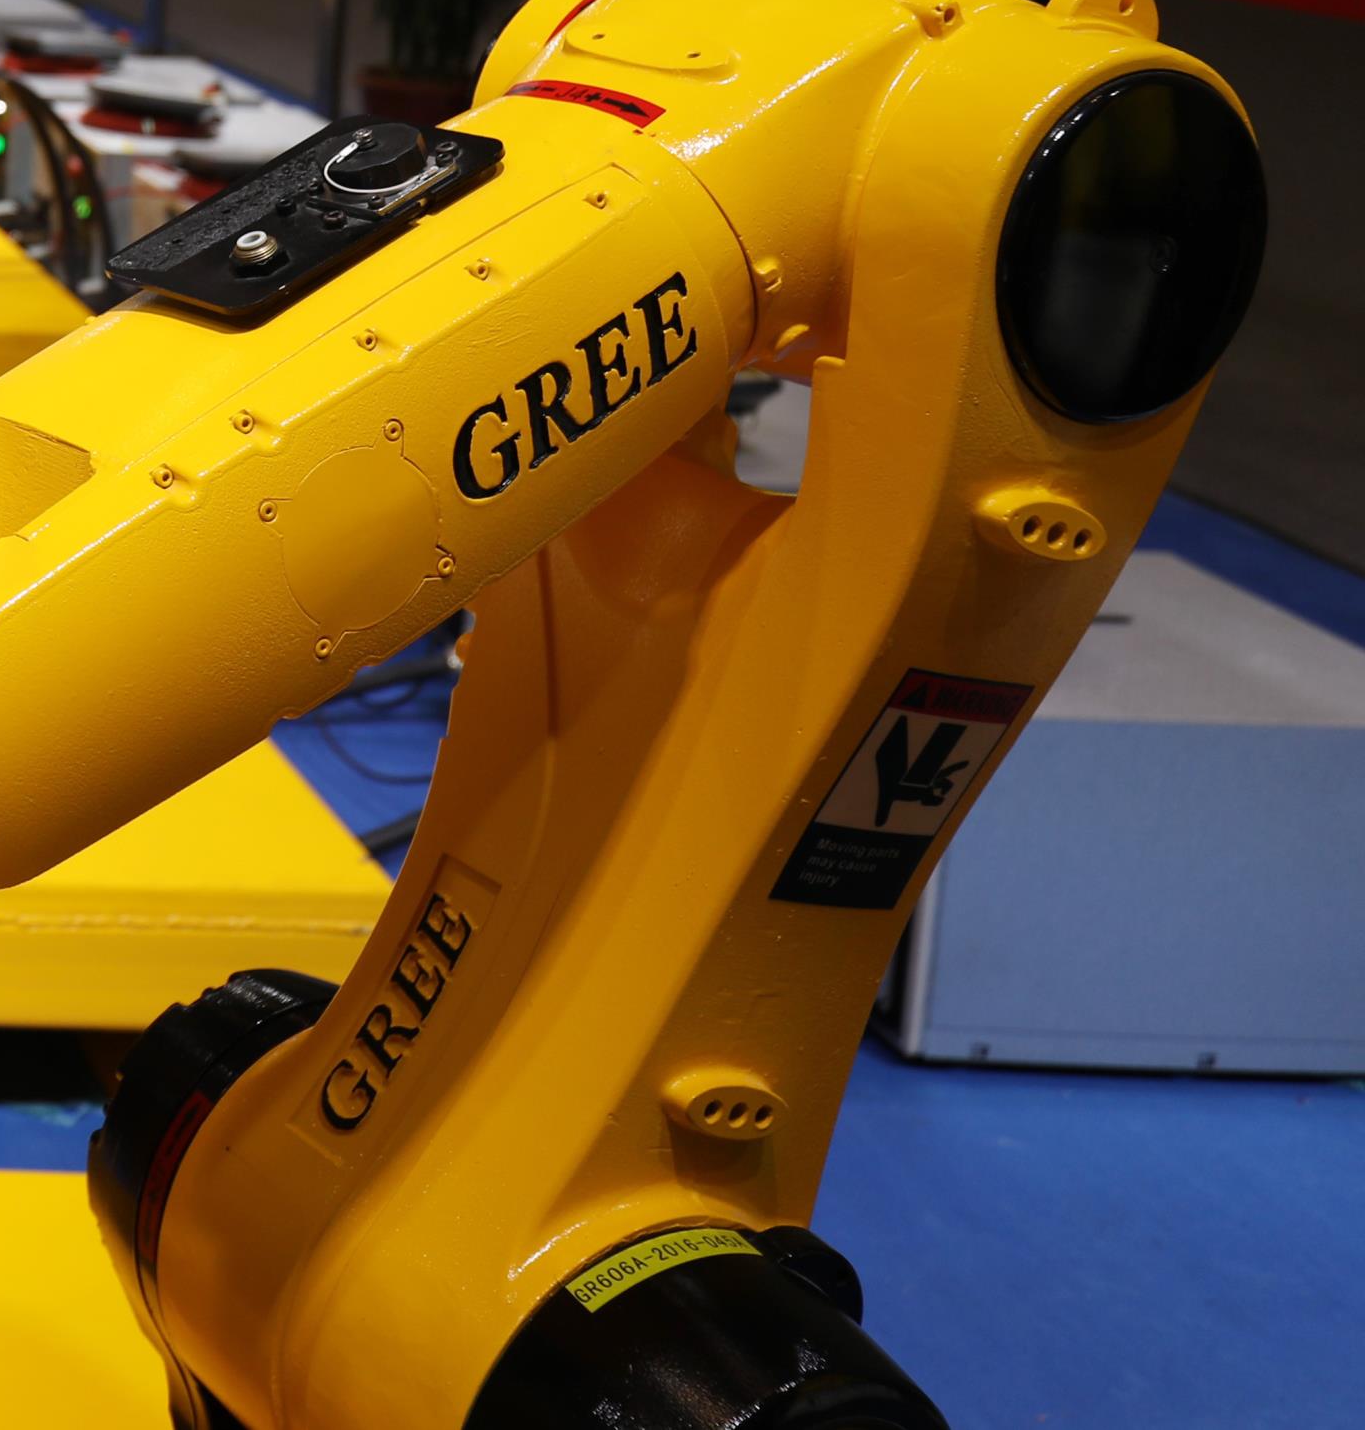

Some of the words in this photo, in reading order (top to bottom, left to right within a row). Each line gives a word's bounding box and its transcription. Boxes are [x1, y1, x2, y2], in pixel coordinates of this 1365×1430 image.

[452, 271, 698, 500] GREE
[816, 837, 866, 859] Moving
[807, 855, 836, 870] may
[837, 858, 878, 873] cause
[797, 866, 841, 887] injury
[320, 892, 473, 1132] GREE
